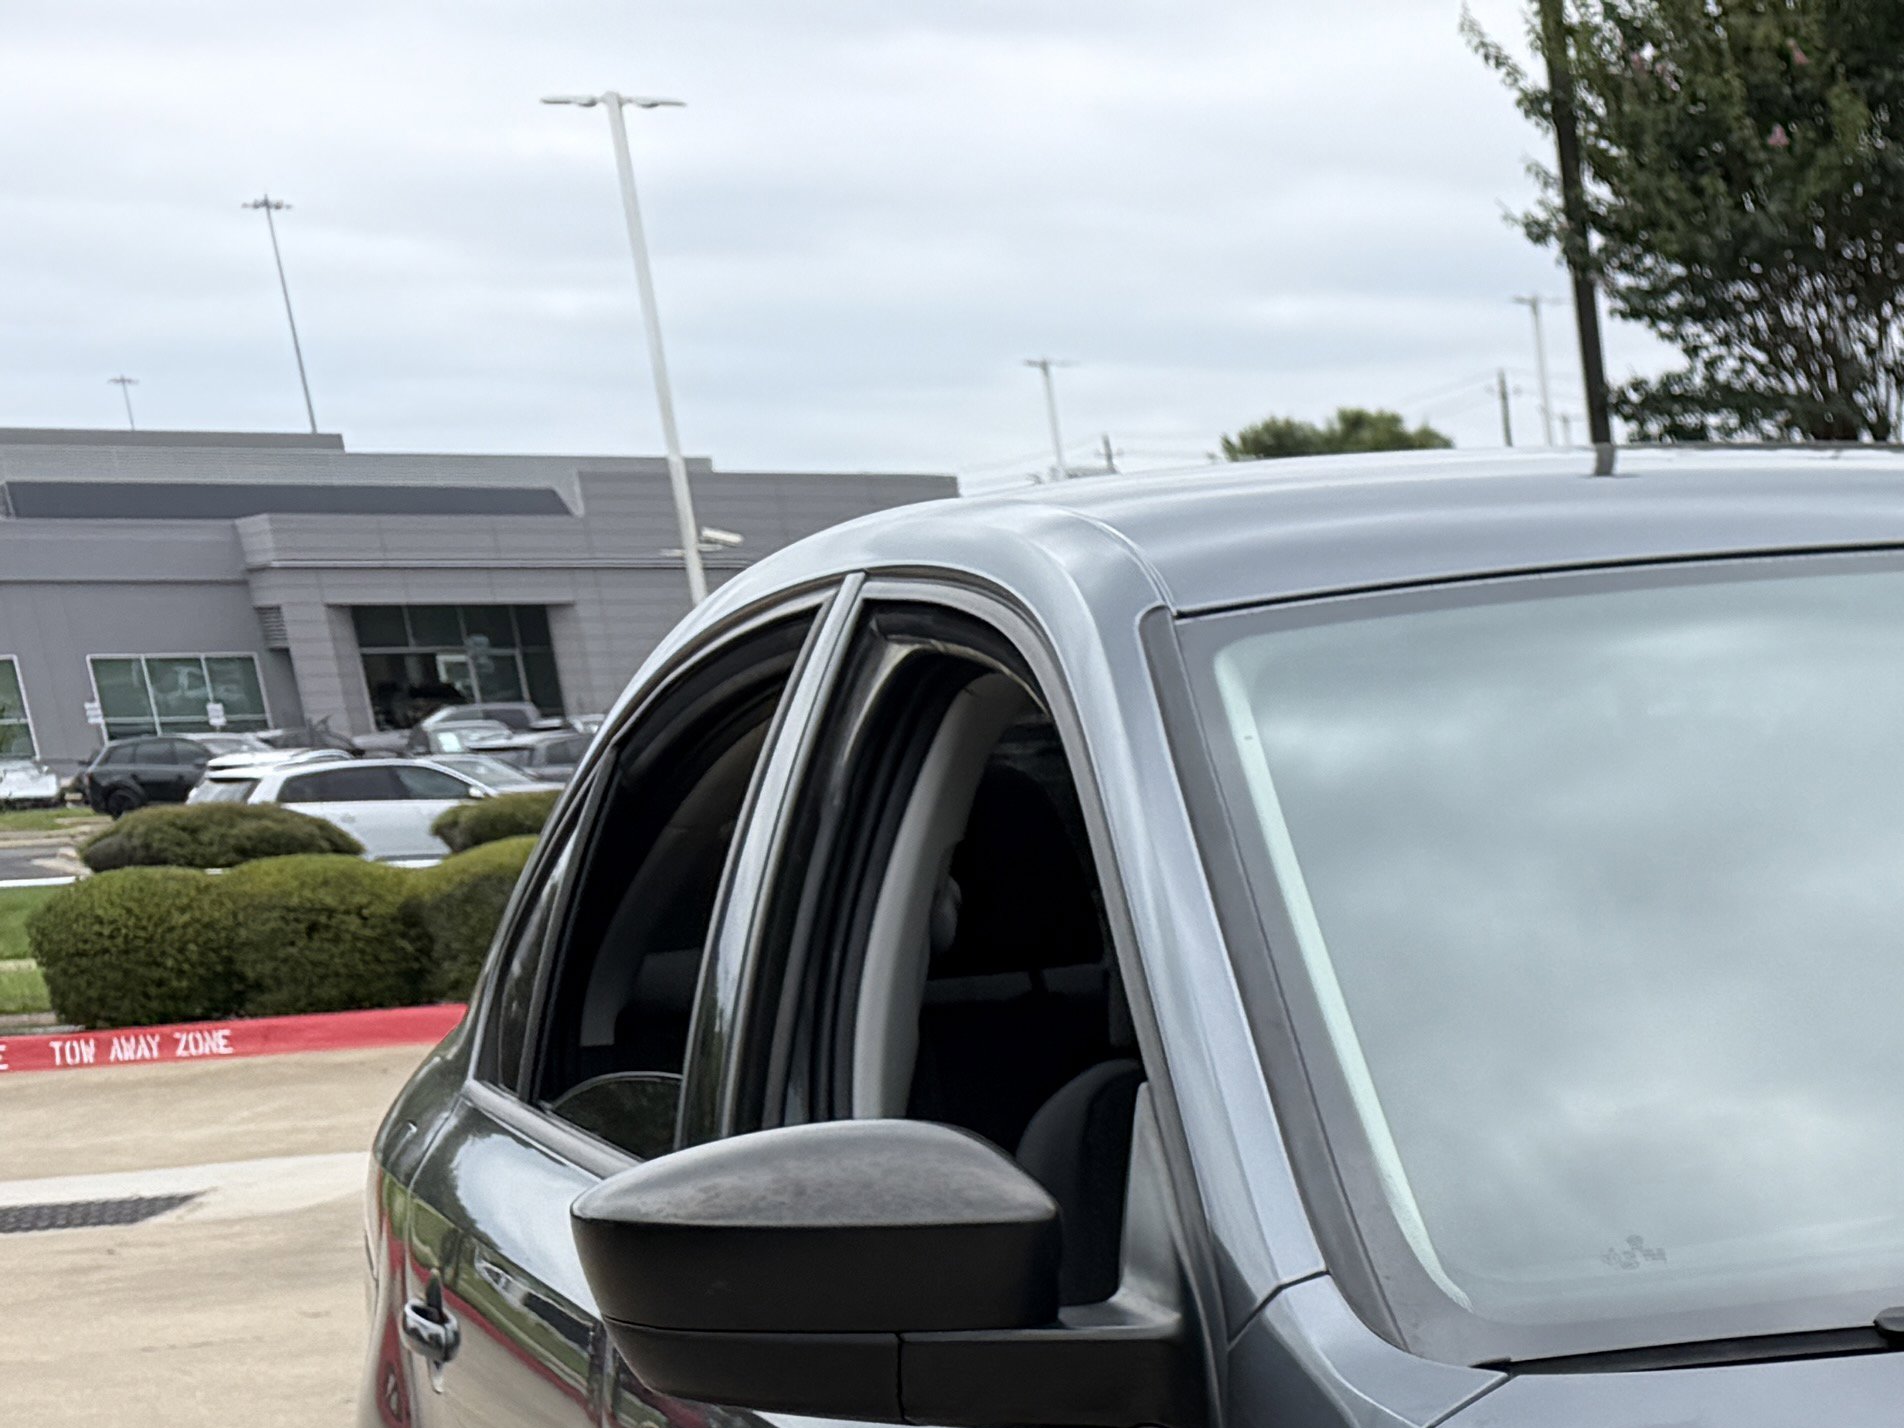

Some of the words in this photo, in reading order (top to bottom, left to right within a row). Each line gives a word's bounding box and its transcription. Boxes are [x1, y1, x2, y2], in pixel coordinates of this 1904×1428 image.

[50, 1037, 95, 1066] TOW
[109, 1034, 160, 1062] AWAY
[174, 1028, 234, 1057] ZONE
